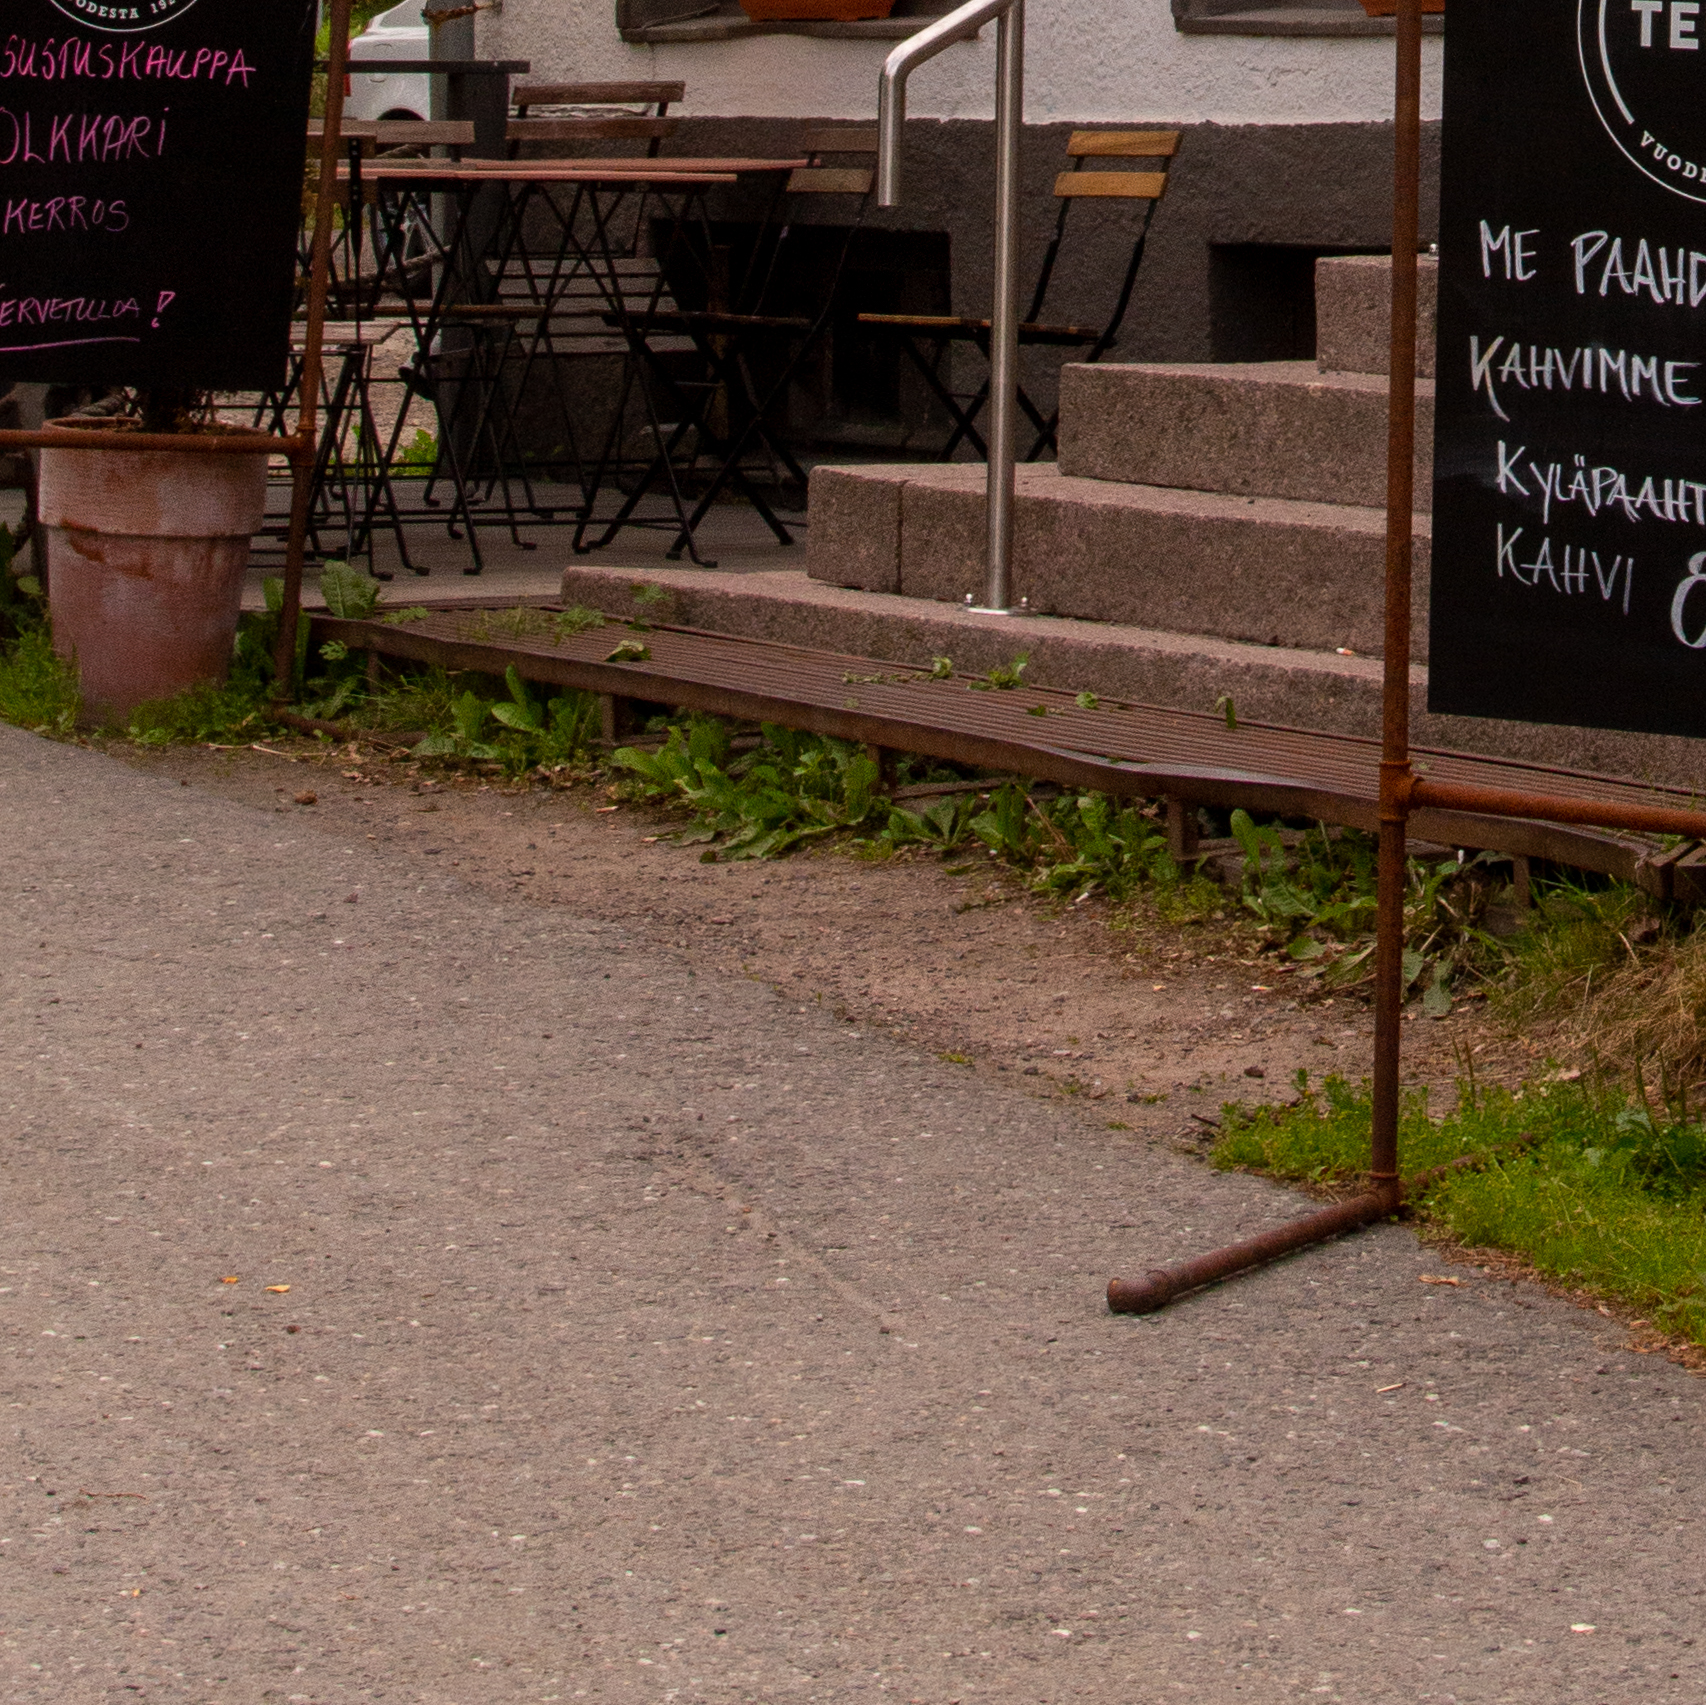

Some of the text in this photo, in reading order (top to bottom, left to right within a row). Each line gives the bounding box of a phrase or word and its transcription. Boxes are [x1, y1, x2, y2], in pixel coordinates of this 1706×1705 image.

[4, 196, 130, 234] KERROS
[1479, 220, 1540, 281] ME
[1470, 335, 1703, 422] KAHVIMME
[1497, 523, 1634, 616] KAHVI
